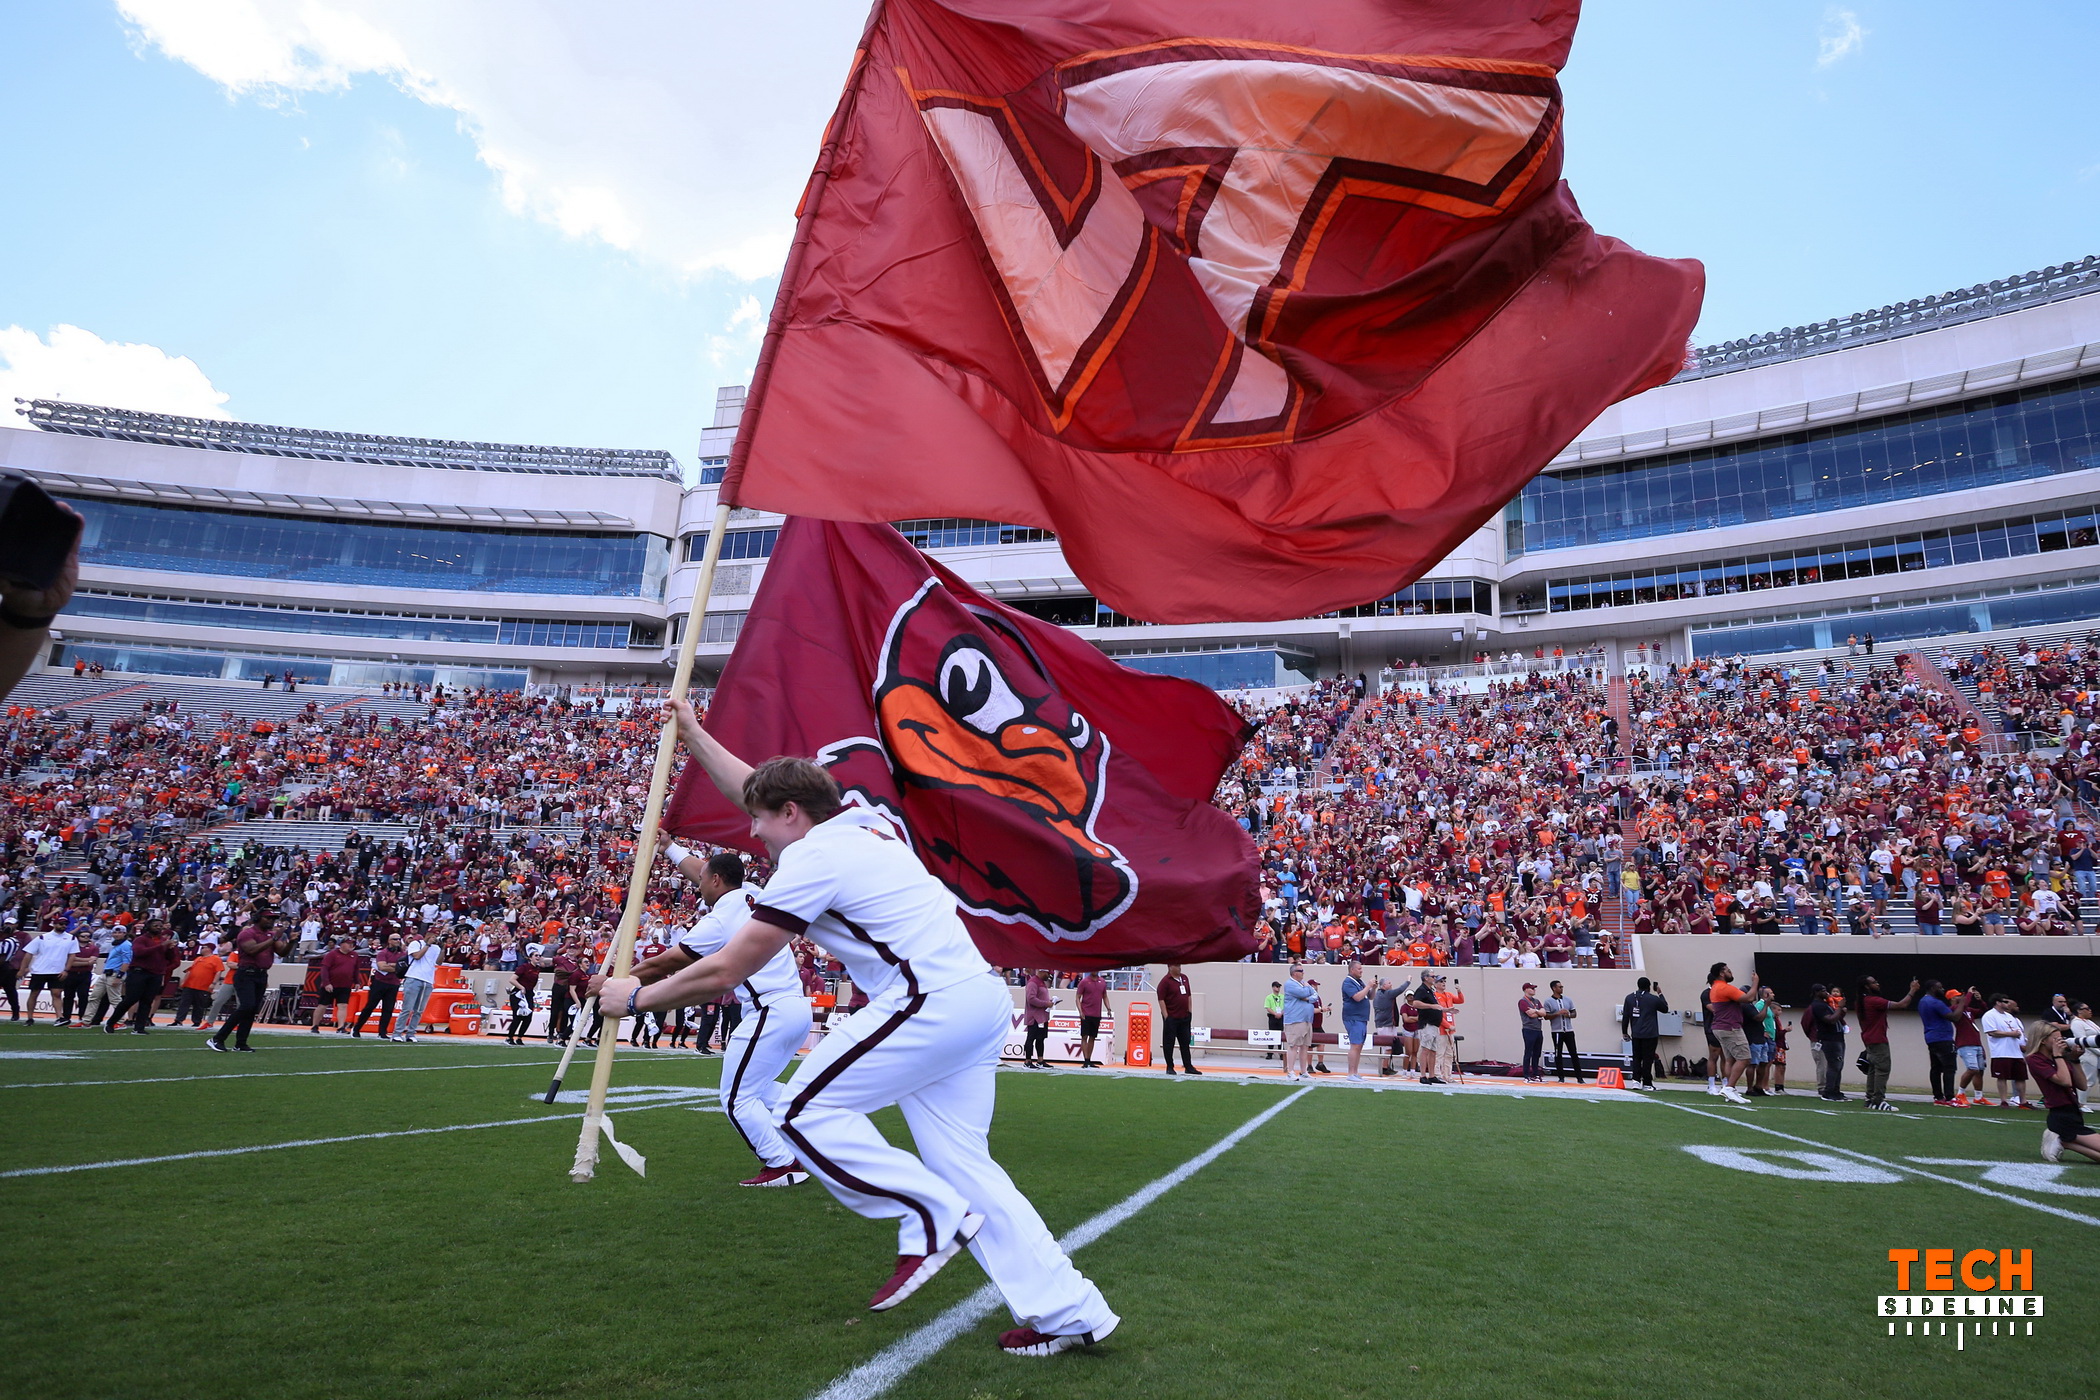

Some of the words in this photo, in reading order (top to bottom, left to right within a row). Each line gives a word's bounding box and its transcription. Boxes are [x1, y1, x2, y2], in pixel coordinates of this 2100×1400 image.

[895, 38, 1564, 453] VT
[1429, 897, 1437, 906] 3
[1587, 893, 1599, 904] 25
[2066, 894, 2076, 906] 5
[468, 1020, 477, 1031] G
[1132, 1048, 1144, 1061] G
[1599, 1068, 1617, 1085] 20
